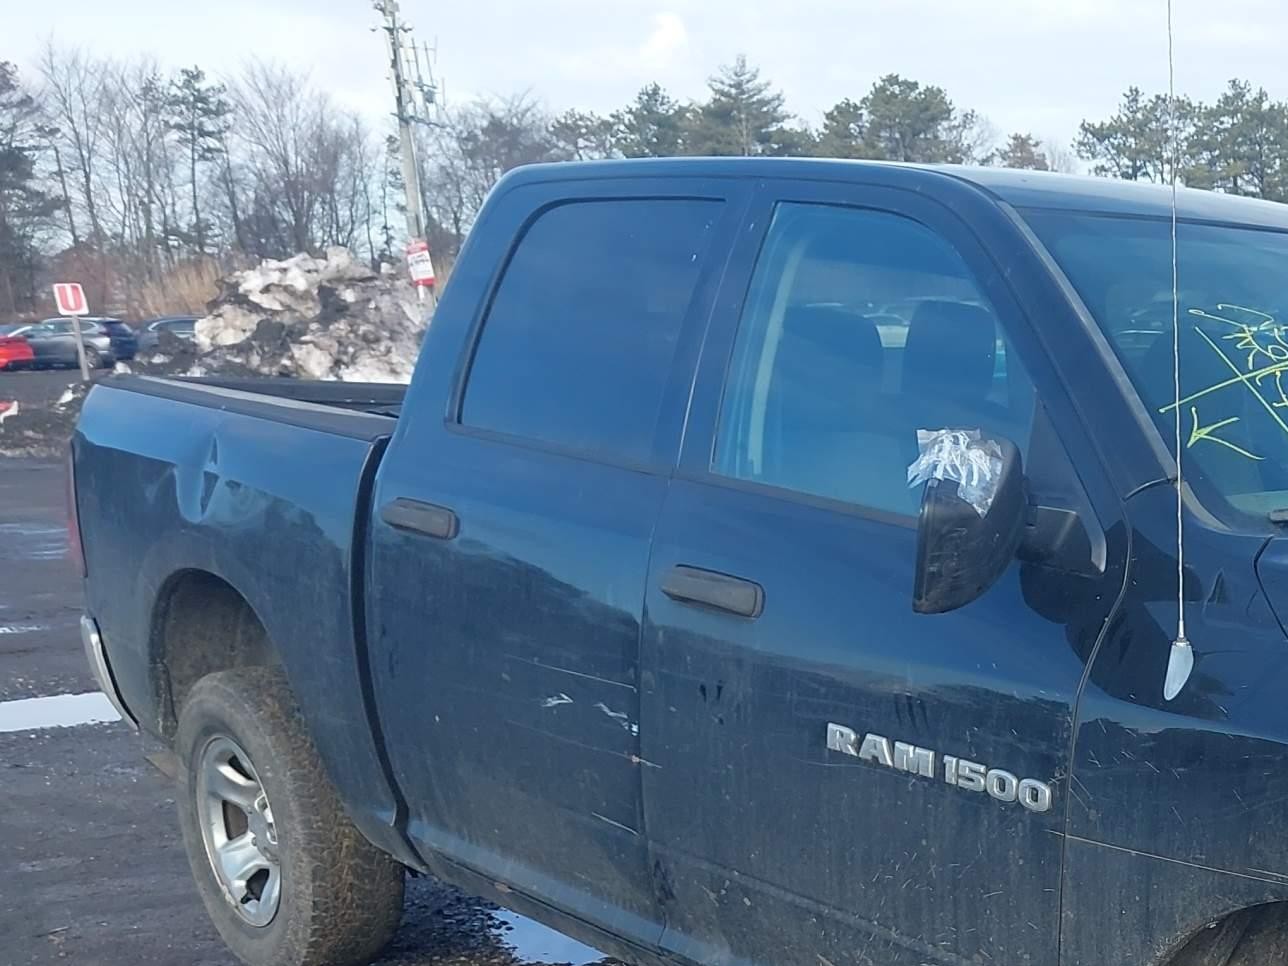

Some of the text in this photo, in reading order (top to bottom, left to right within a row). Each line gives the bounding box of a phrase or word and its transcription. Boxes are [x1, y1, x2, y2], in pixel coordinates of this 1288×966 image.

[57, 284, 84, 312] U
[825, 721, 1053, 813] RAM 1500
